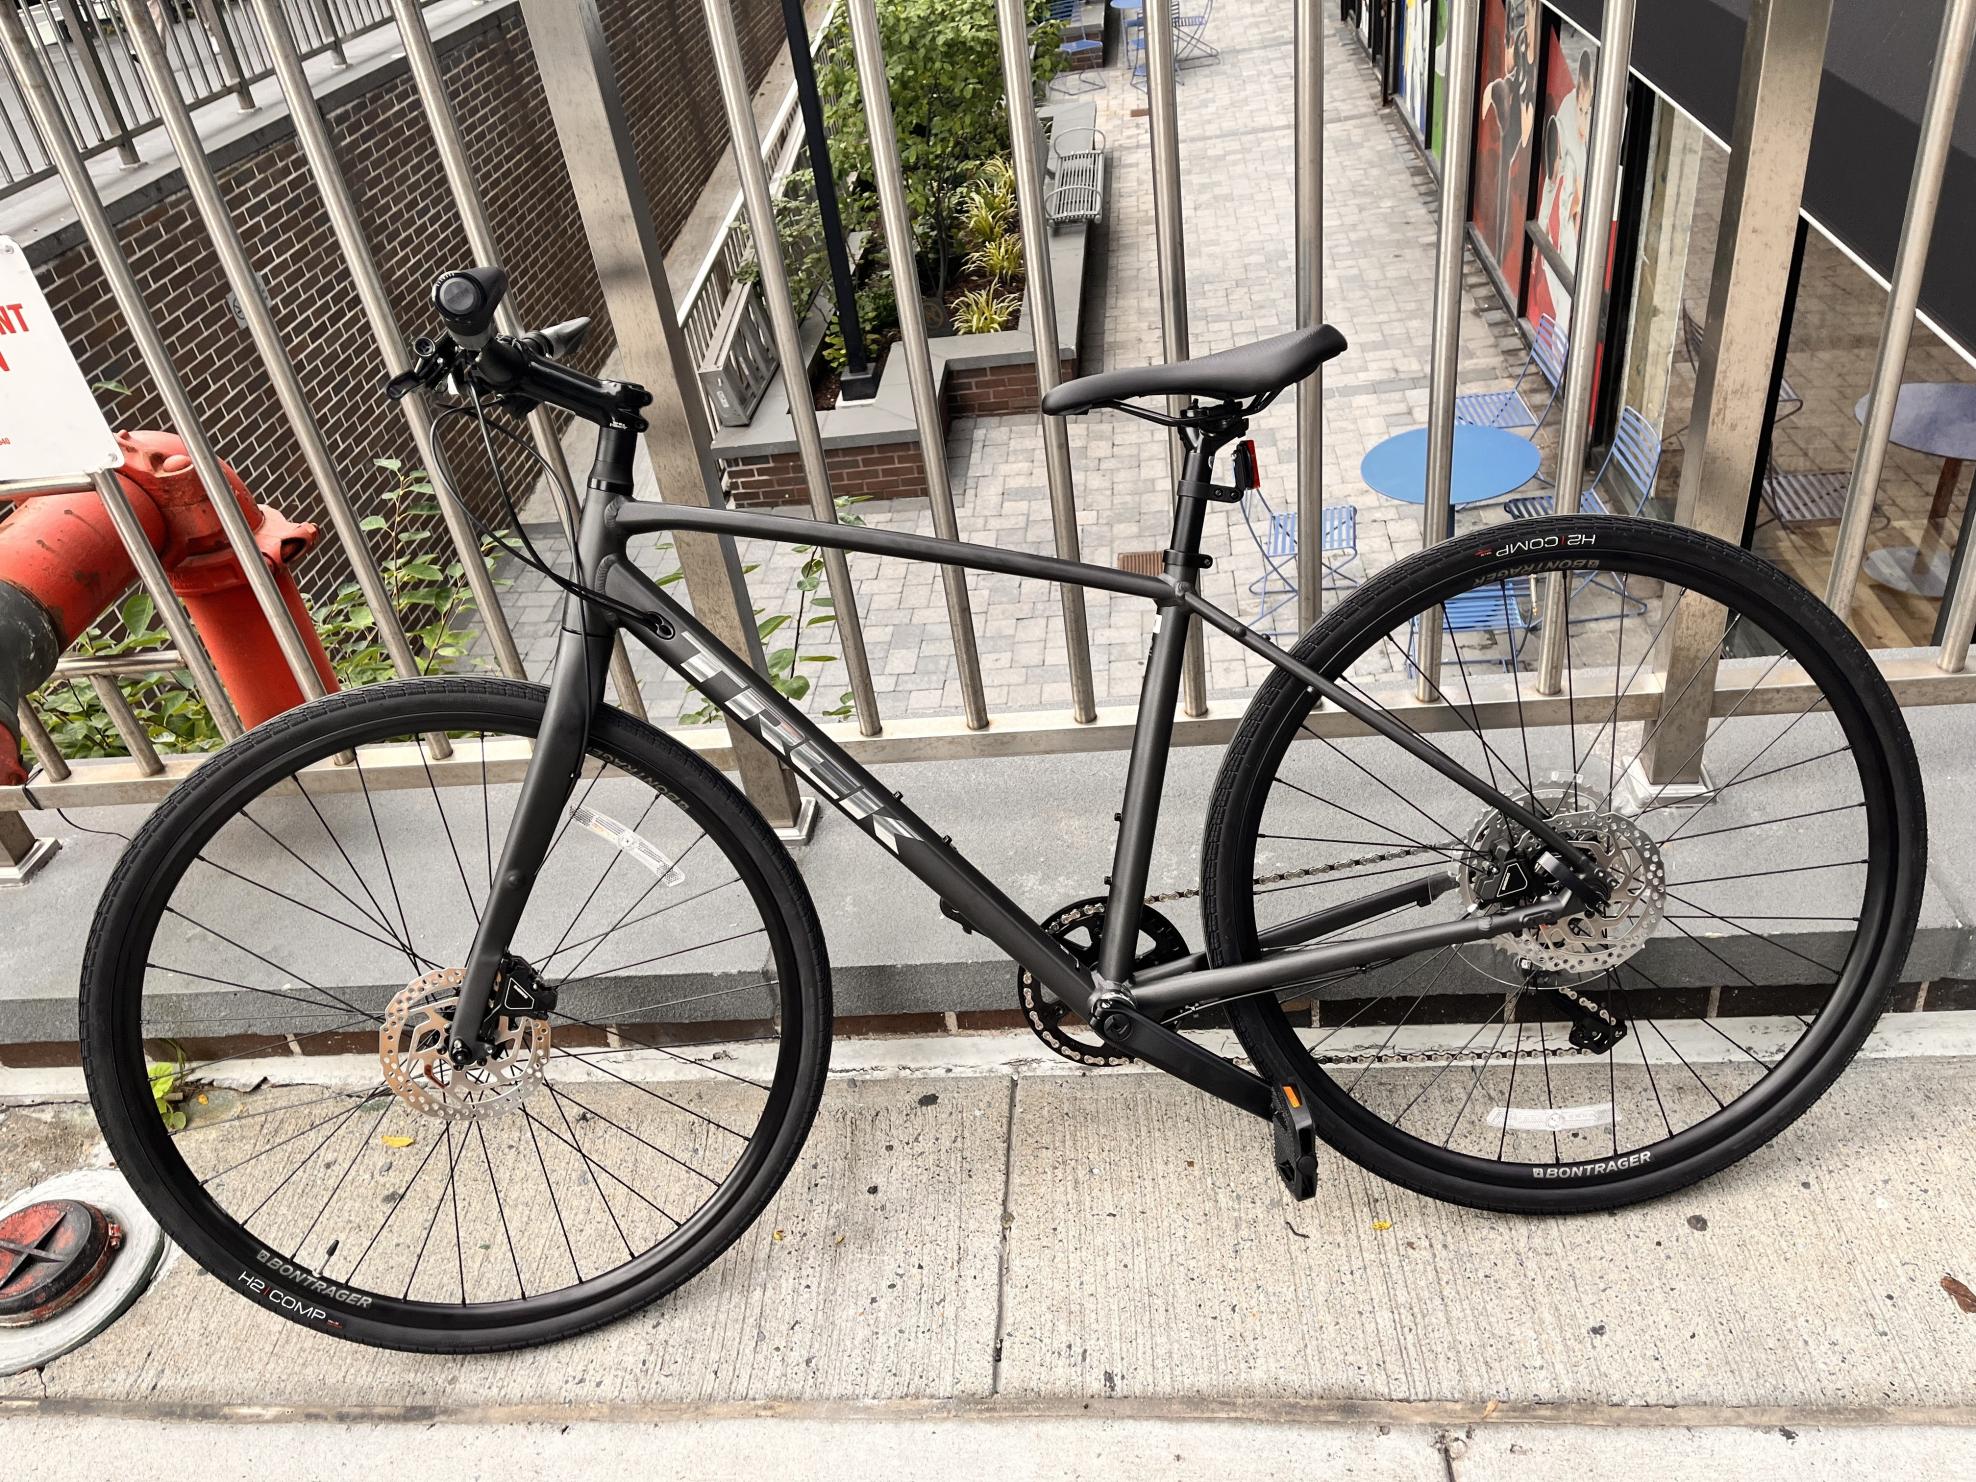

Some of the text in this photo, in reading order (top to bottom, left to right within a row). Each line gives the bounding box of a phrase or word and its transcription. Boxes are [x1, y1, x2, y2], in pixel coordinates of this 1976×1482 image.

[1496, 537, 1559, 557] COMP
[1568, 534, 1596, 545] H2
[680, 631, 926, 854] TREK
[1546, 1151, 1651, 1179] BONTRAGER
[238, 1271, 326, 1320] H2 COMP
[266, 1258, 372, 1308] BONTRAGER
